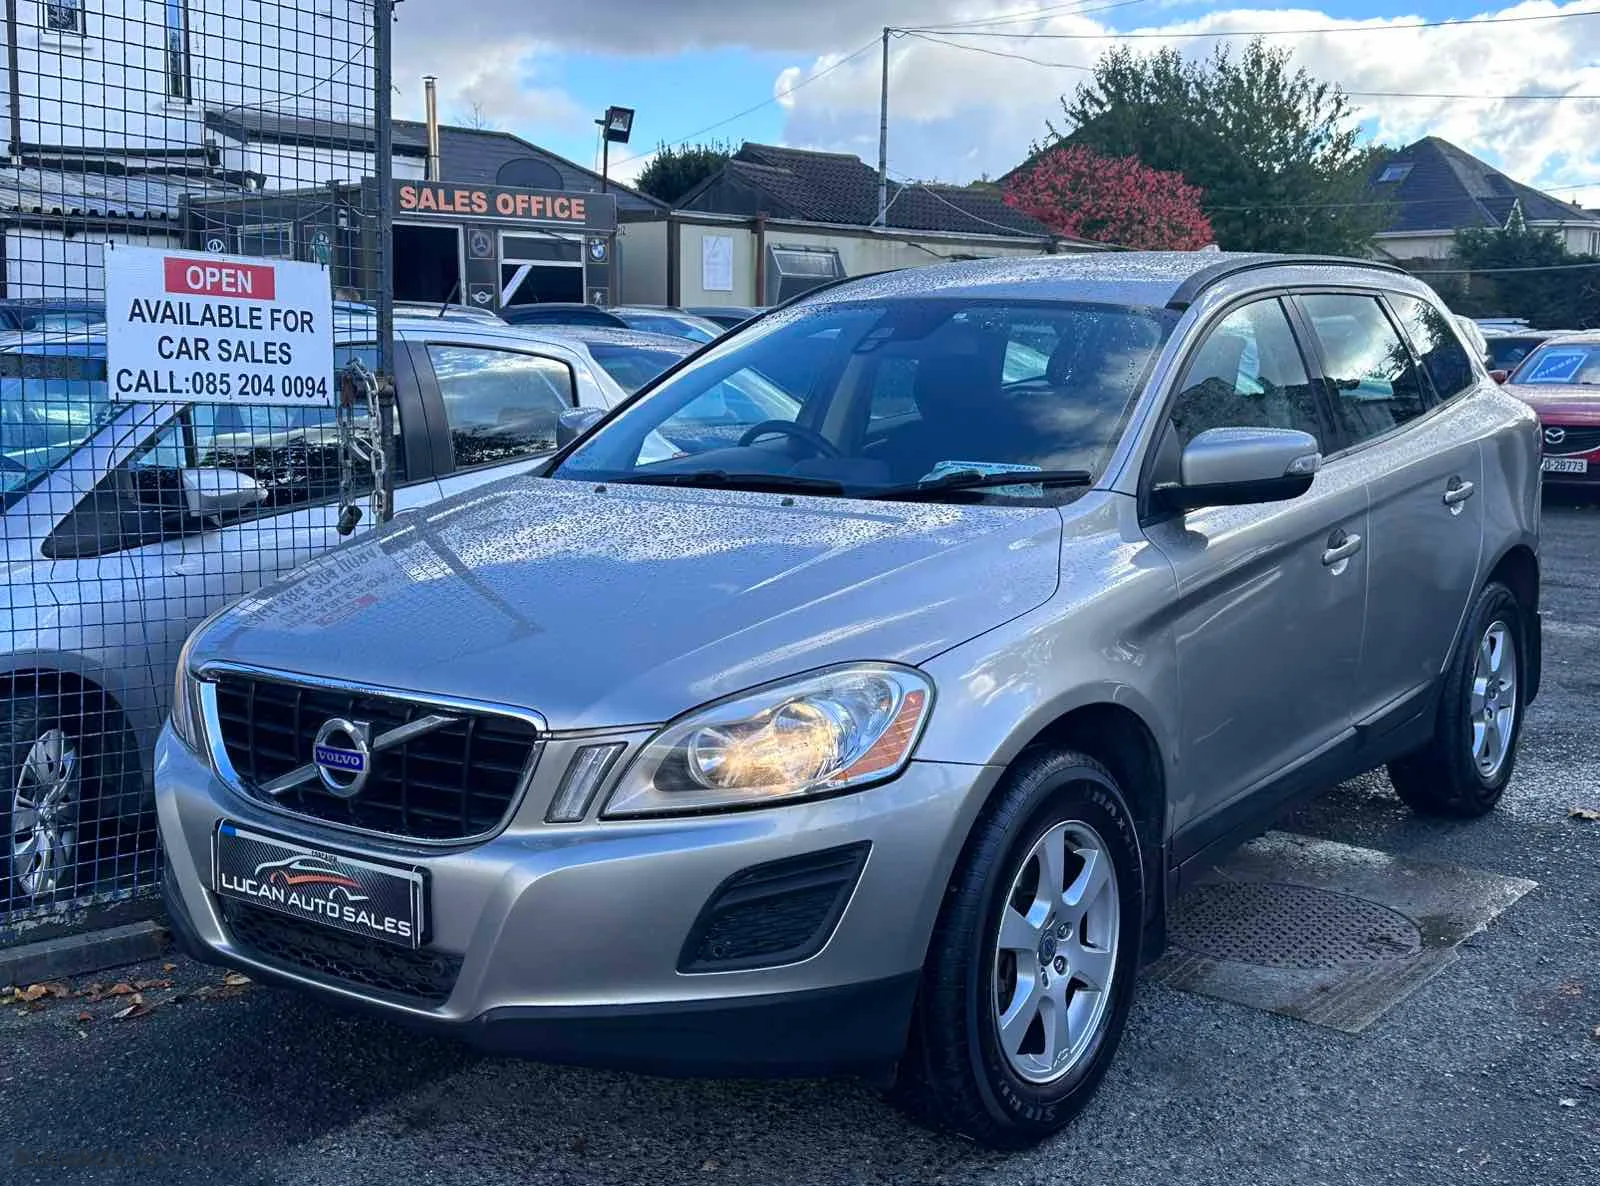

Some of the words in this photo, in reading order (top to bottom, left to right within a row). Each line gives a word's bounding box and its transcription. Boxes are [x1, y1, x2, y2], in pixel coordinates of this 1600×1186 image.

[399, 186, 488, 213] SALES
[496, 193, 586, 219] OFFICE
[186, 265, 252, 293] OPEN
[128, 298, 263, 330] AVAILABLE
[270, 308, 314, 334] FOR
[158, 335, 210, 361] CAR
[218, 339, 292, 366] SALES
[116, 368, 231, 396] CALL:085
[238, 373, 276, 397] 204
[281, 375, 328, 399] 0094
[317, 750, 361, 766] VOLVO
[221, 872, 285, 902] LUCAN
[288, 892, 340, 918] AUTO
[343, 908, 412, 937] SALES
